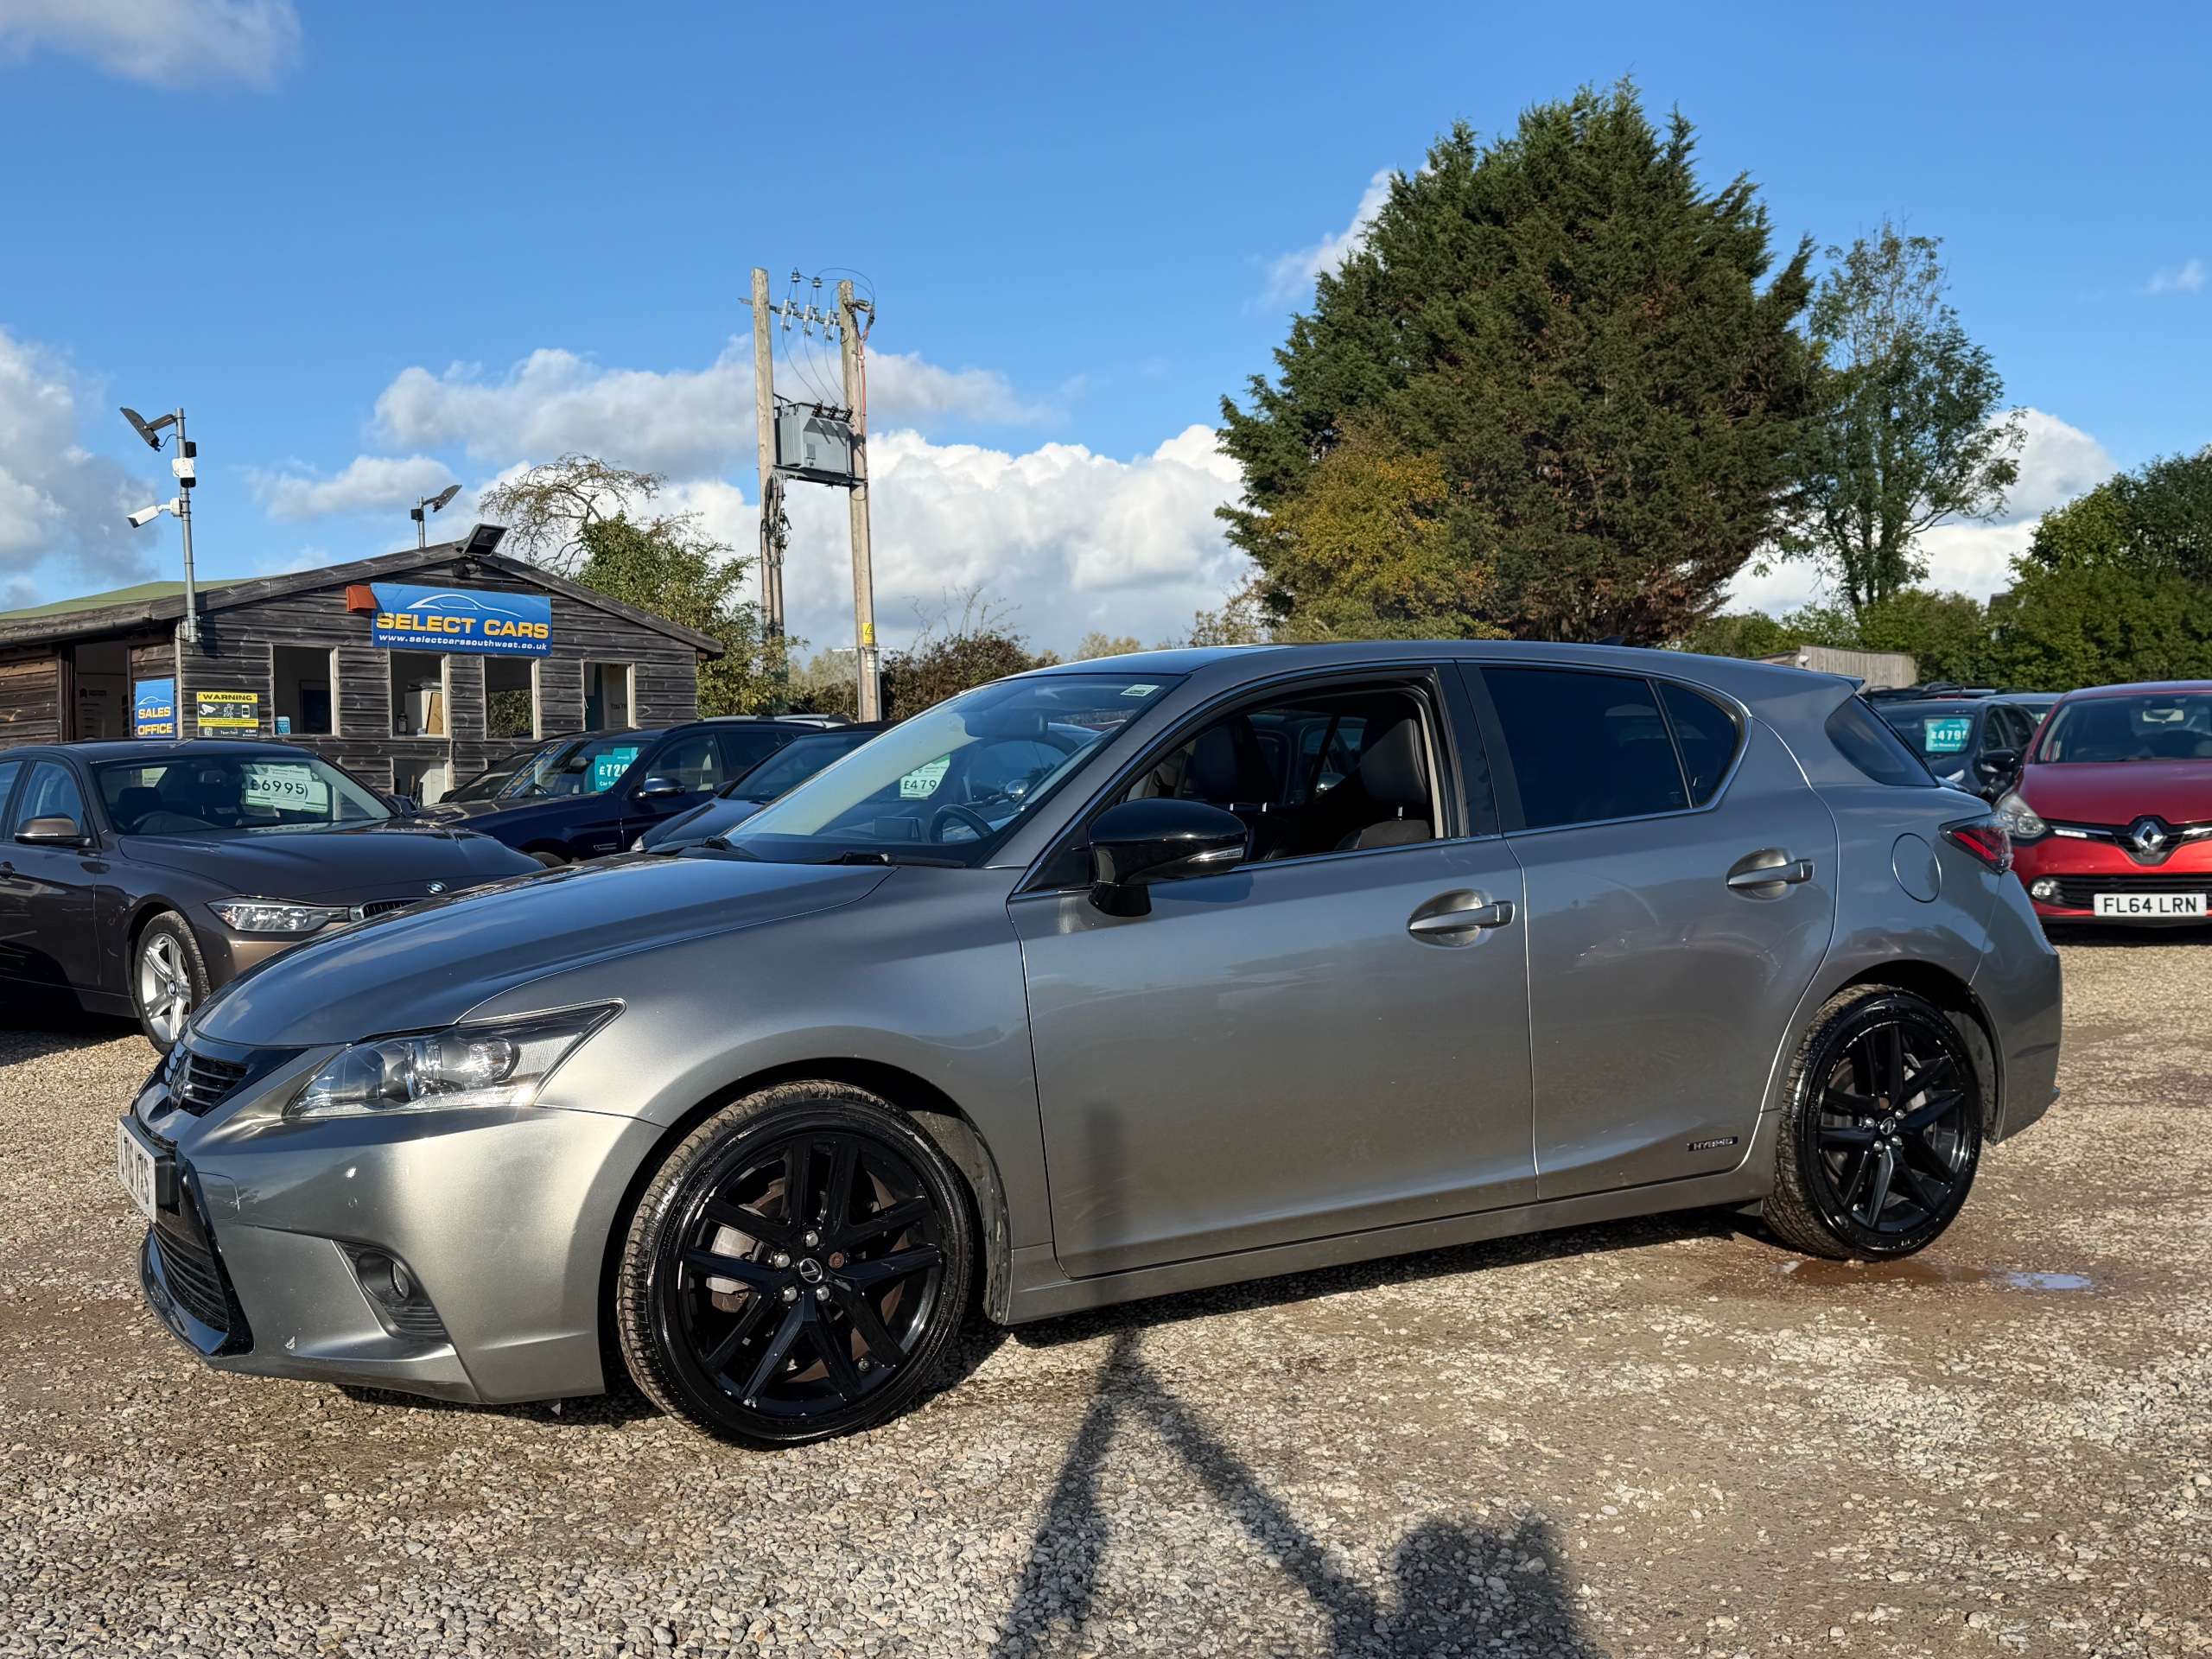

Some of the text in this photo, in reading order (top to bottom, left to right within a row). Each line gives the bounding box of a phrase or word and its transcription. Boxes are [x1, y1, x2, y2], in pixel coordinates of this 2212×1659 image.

[376, 613, 549, 639] SELECT CARS
[378, 634, 547, 651] www.selectcarssouthwest.co.uk
[138, 706, 171, 719] SALES
[137, 722, 173, 735] OFFICE
[2103, 897, 2197, 913] FL64 LRN
